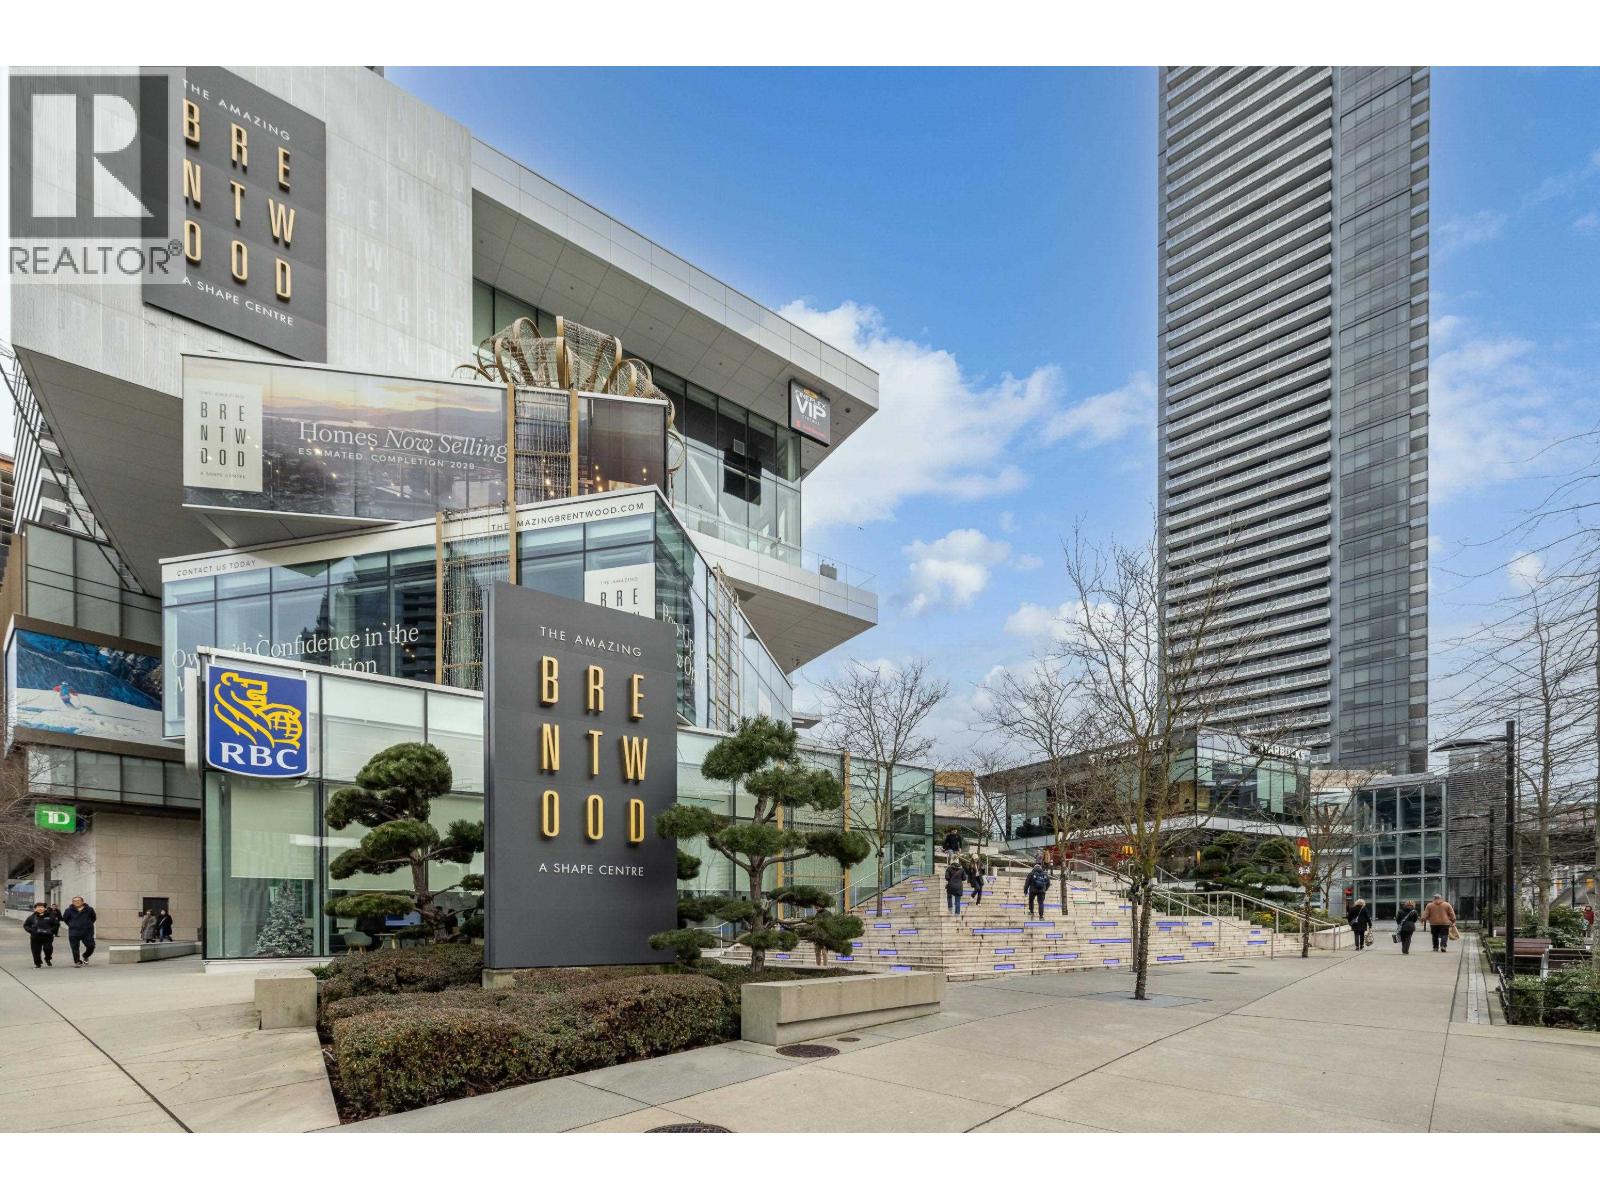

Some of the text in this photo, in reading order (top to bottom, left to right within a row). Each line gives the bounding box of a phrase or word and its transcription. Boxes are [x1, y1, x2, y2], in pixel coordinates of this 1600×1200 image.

[182, 78, 291, 141] THE AMAZING
[182, 276, 294, 326] A SHAPE CENTRE
[796, 394, 827, 419] VIP
[299, 421, 508, 464] Homes Now Selling
[298, 447, 475, 470] ESIMATED COMPLETION 2028
[176, 559, 256, 577] CONTACT US TODAY
[257, 633, 360, 657] Confidence
[365, 627, 384, 647] in
[388, 624, 420, 645] the
[540, 626, 642, 657] THE AMAZING
[220, 741, 299, 770] RBC
[43, 810, 70, 825] TD
[539, 863, 645, 877] A SHAPE CENTRE
